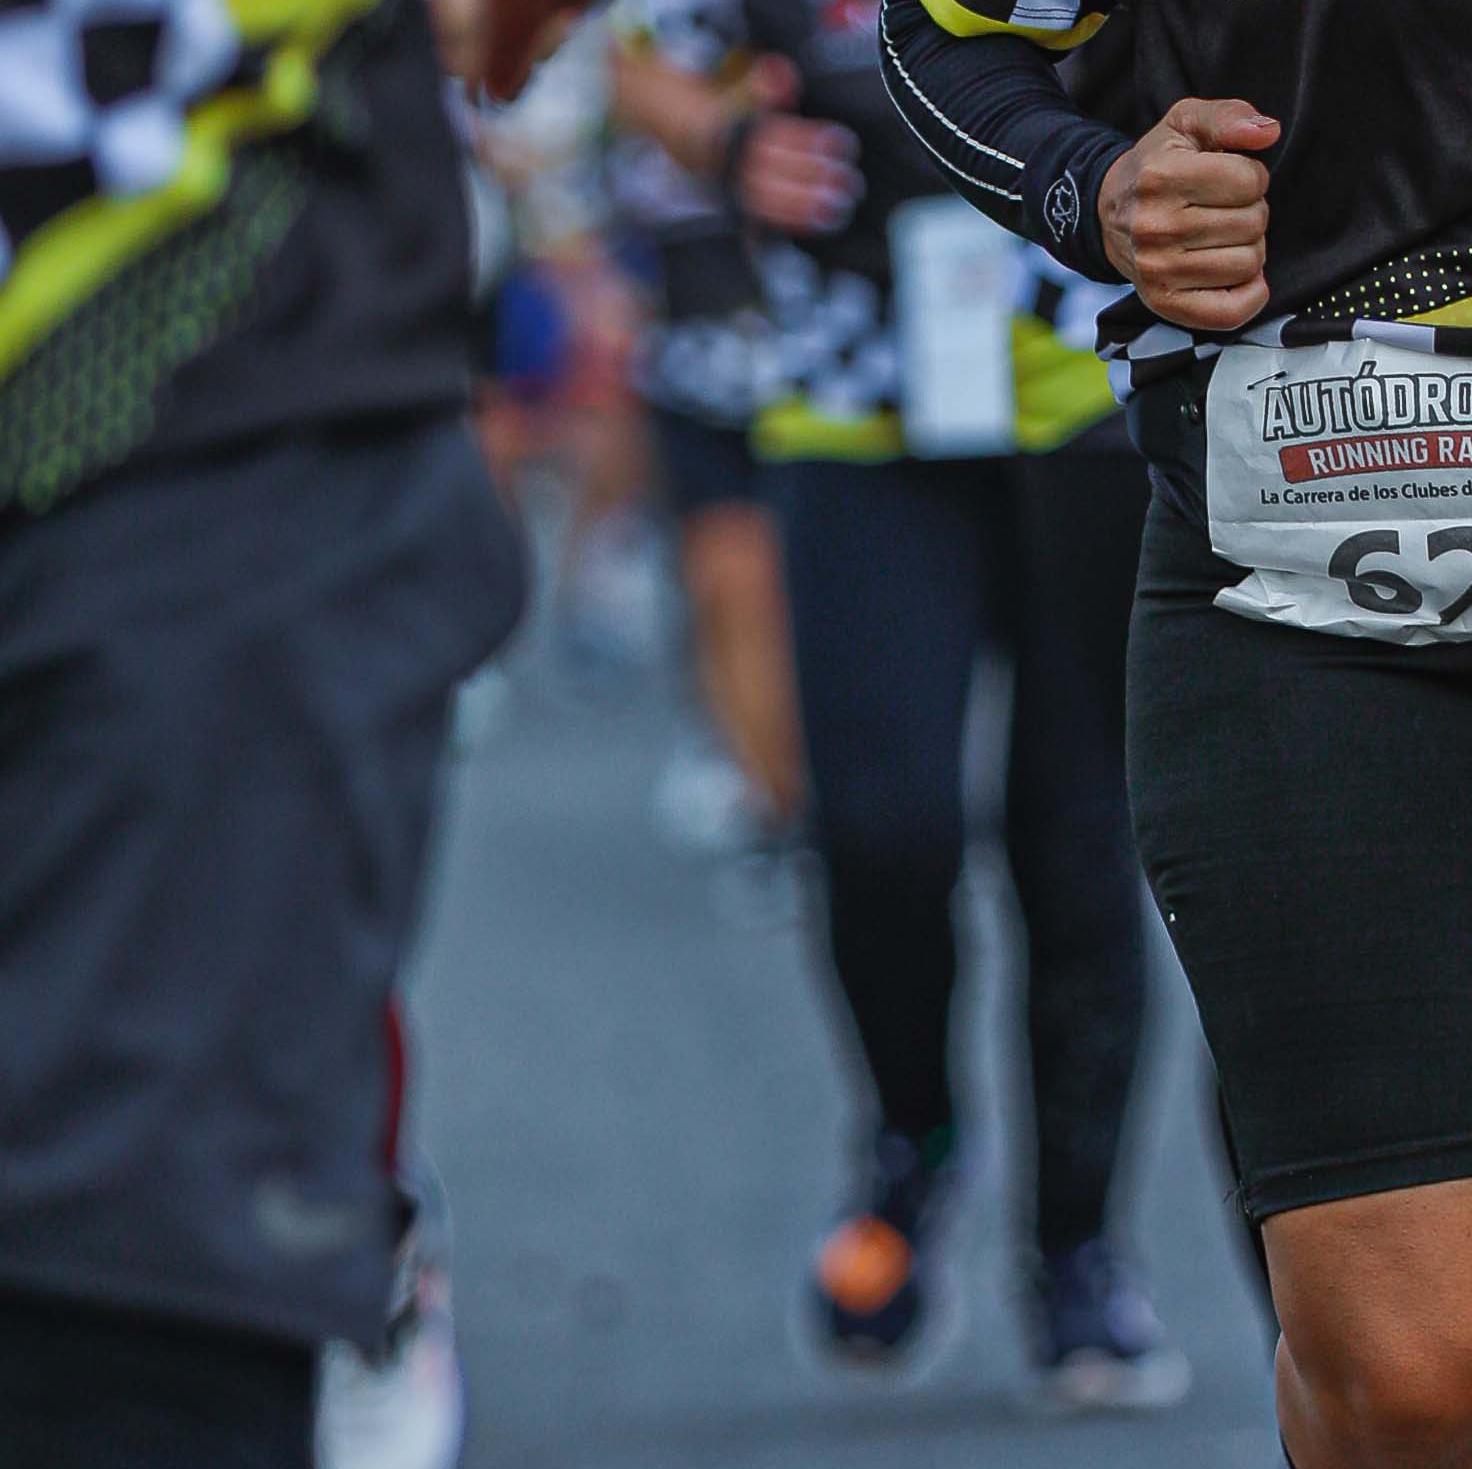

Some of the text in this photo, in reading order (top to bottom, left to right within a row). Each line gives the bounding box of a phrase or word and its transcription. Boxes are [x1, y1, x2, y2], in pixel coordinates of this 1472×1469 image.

[1307, 436, 1428, 476] RUNNING
[1260, 488, 1279, 505] La
[1283, 487, 1344, 505] Carrera
[1348, 484, 1370, 502] de
[1374, 483, 1398, 500] los
[1401, 481, 1458, 499] Clubes
